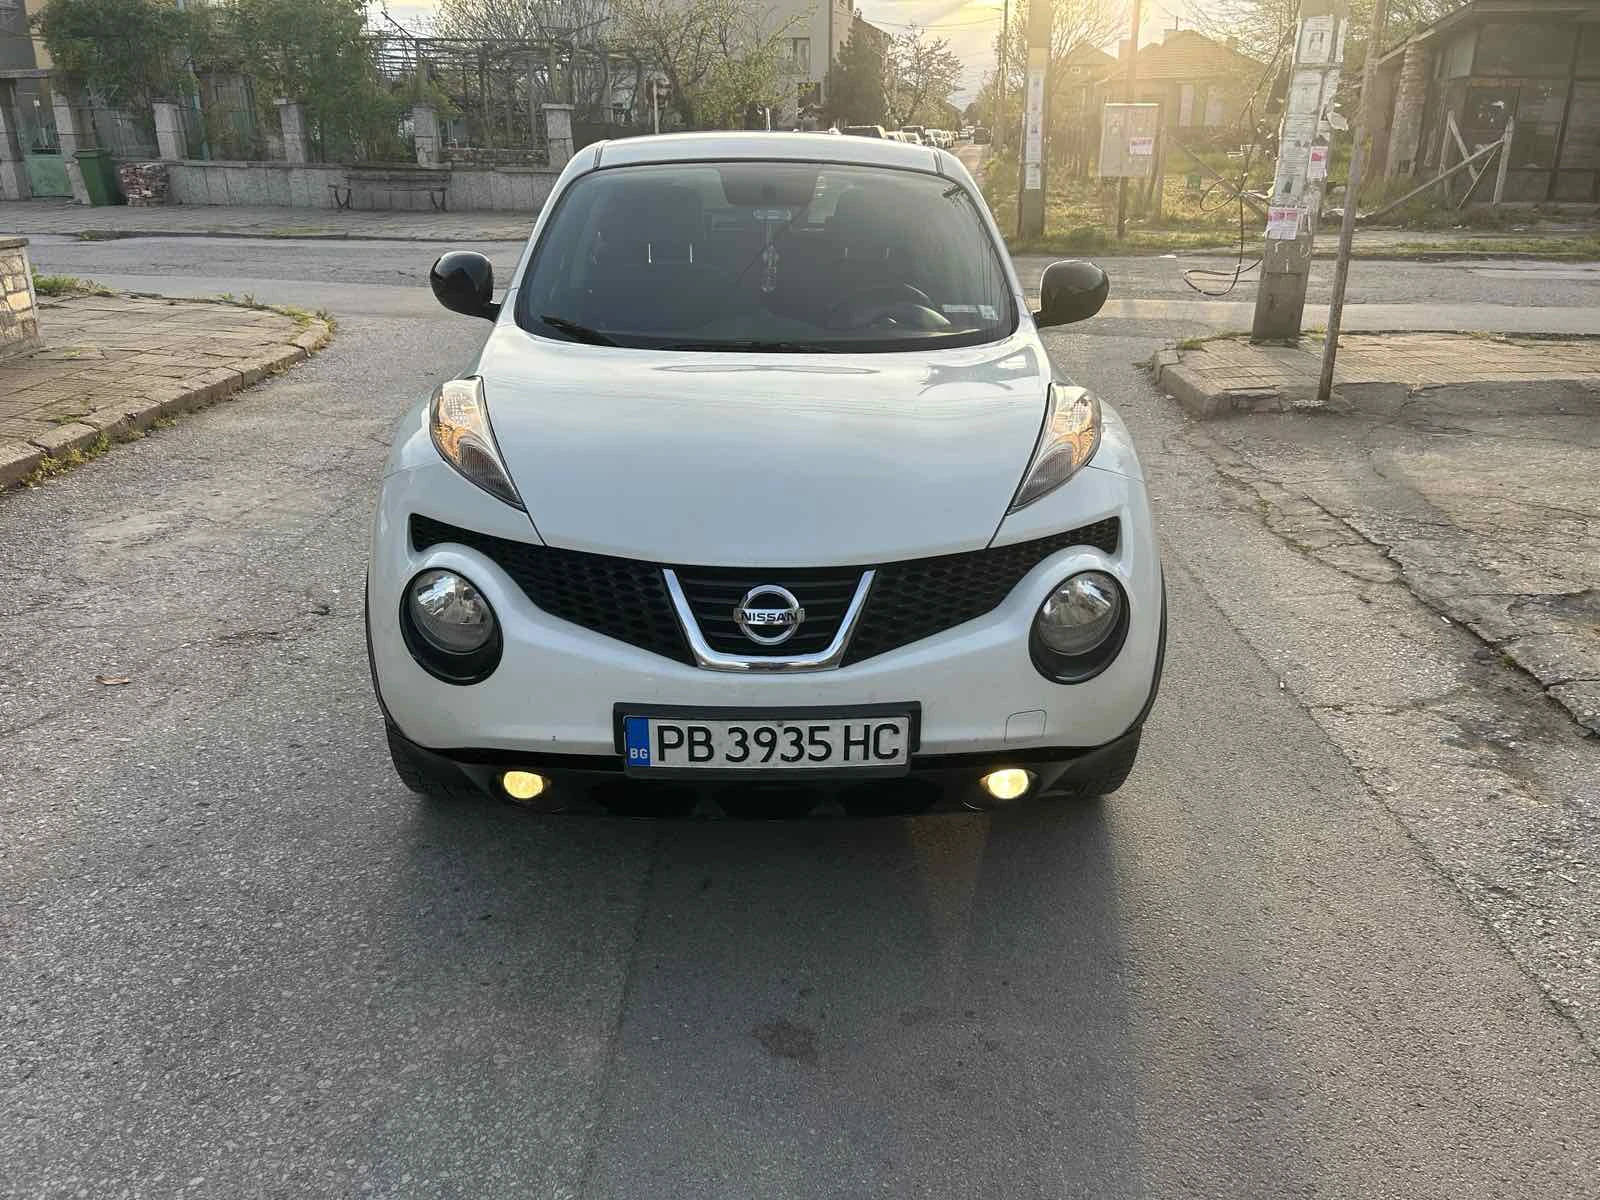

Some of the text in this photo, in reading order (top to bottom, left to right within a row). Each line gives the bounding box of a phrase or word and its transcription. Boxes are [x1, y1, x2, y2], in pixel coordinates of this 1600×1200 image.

[741, 612, 797, 622] NISSAN
[657, 723, 900, 762] PB 3935 HC
[630, 748, 648, 759] BG
